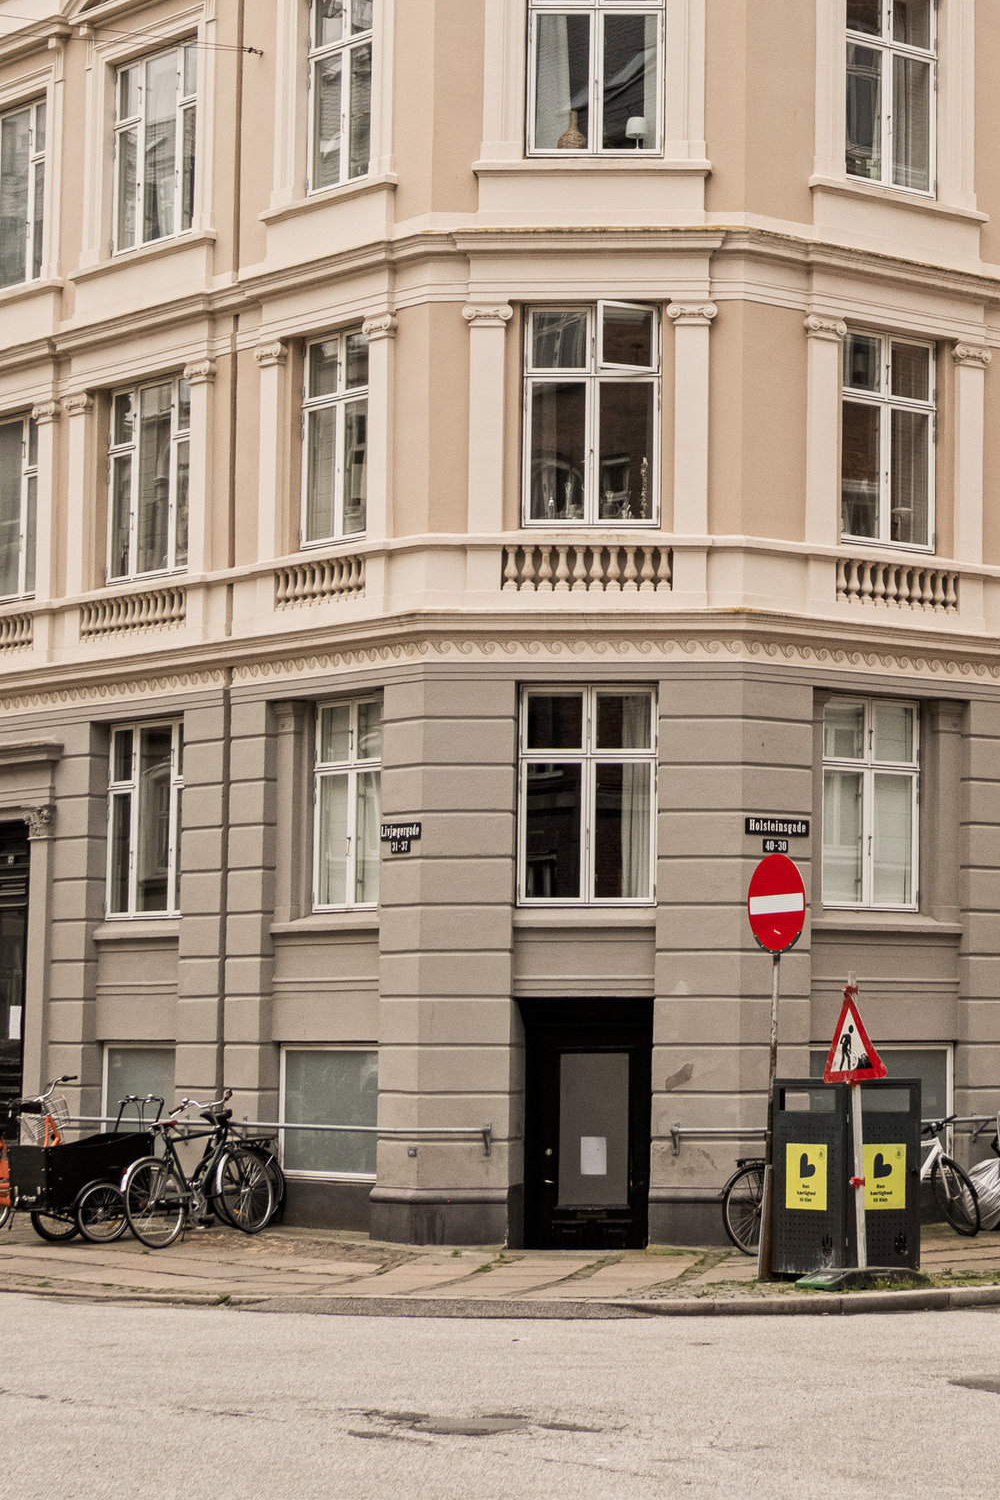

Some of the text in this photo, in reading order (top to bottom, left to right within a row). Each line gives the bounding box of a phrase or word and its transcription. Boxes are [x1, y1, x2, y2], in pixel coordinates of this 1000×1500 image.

[381, 824, 419, 839] Livjægergade
[749, 818, 806, 834] Holsteinsgade
[391, 841, 408, 851] 31-37
[765, 840, 787, 851] 40-30
